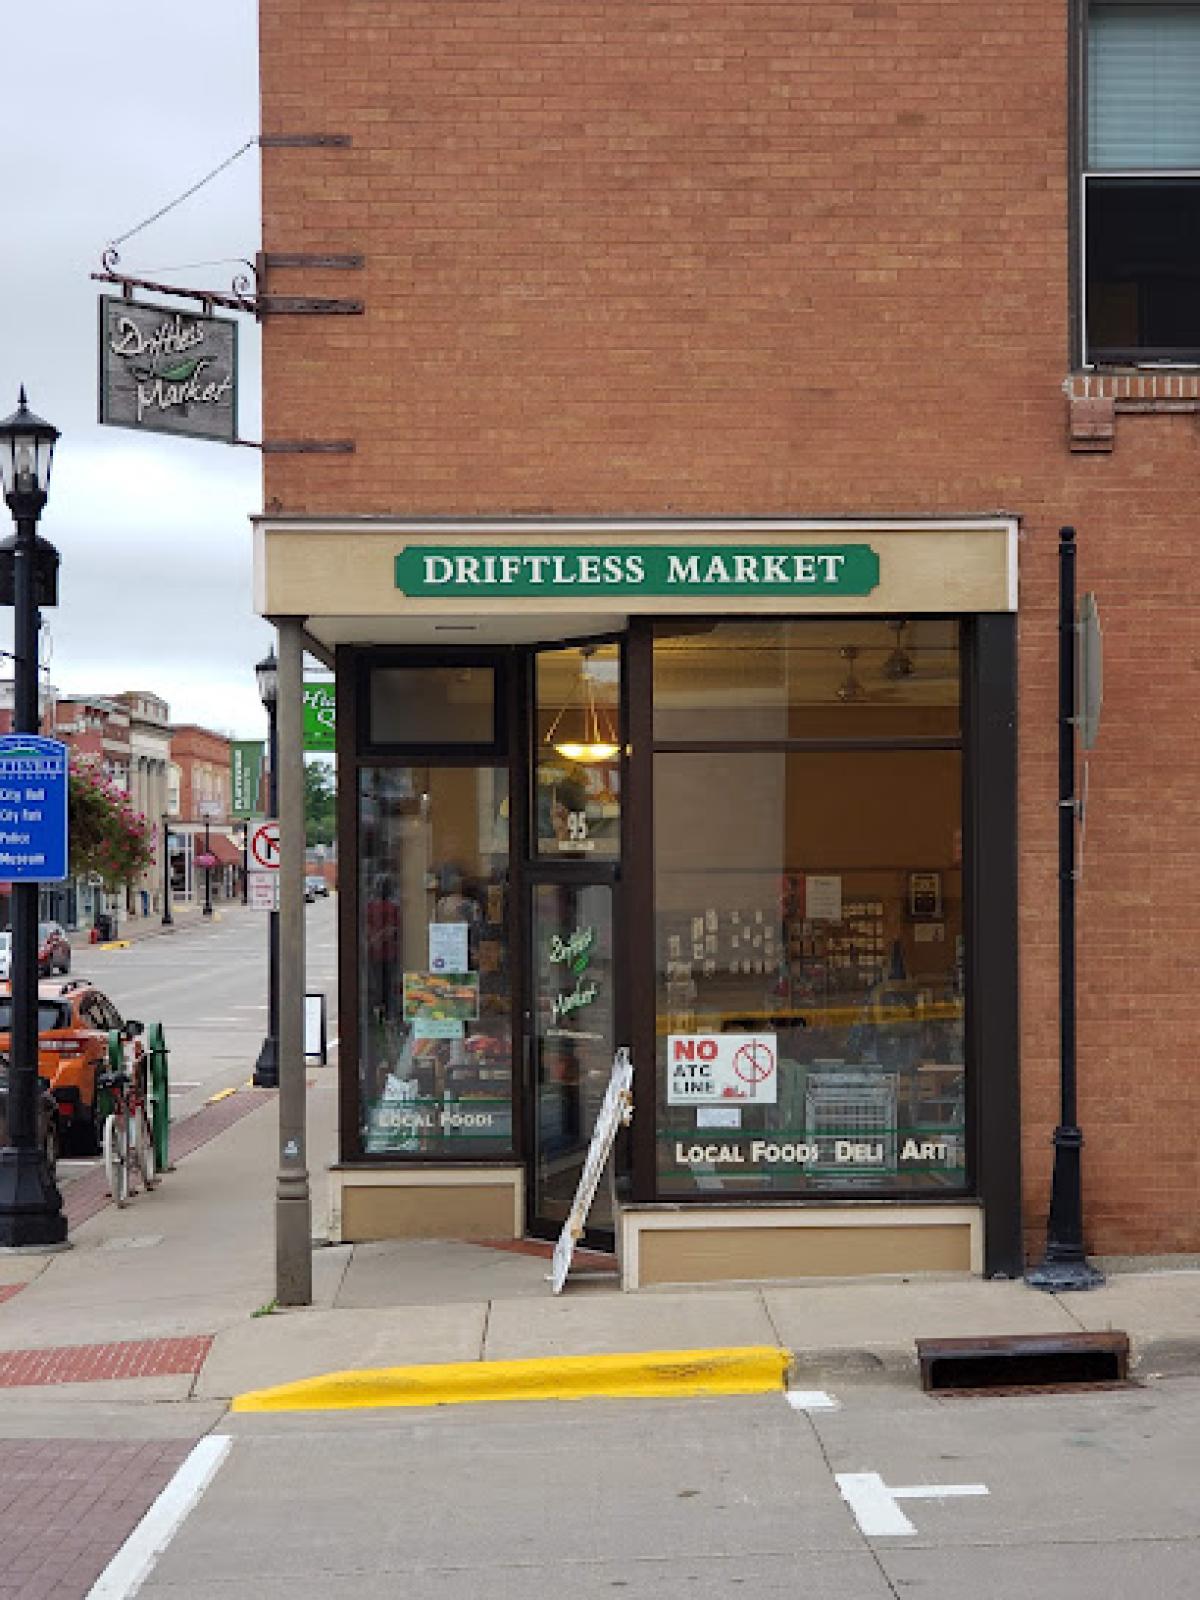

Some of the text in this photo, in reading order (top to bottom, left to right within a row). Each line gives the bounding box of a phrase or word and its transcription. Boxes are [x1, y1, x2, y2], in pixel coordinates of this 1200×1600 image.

[422, 555, 845, 584] DRIFTLESS MARKET
[673, 1039, 719, 1062] NO
[673, 1063, 712, 1078] ATC
[673, 1081, 716, 1095] LINE
